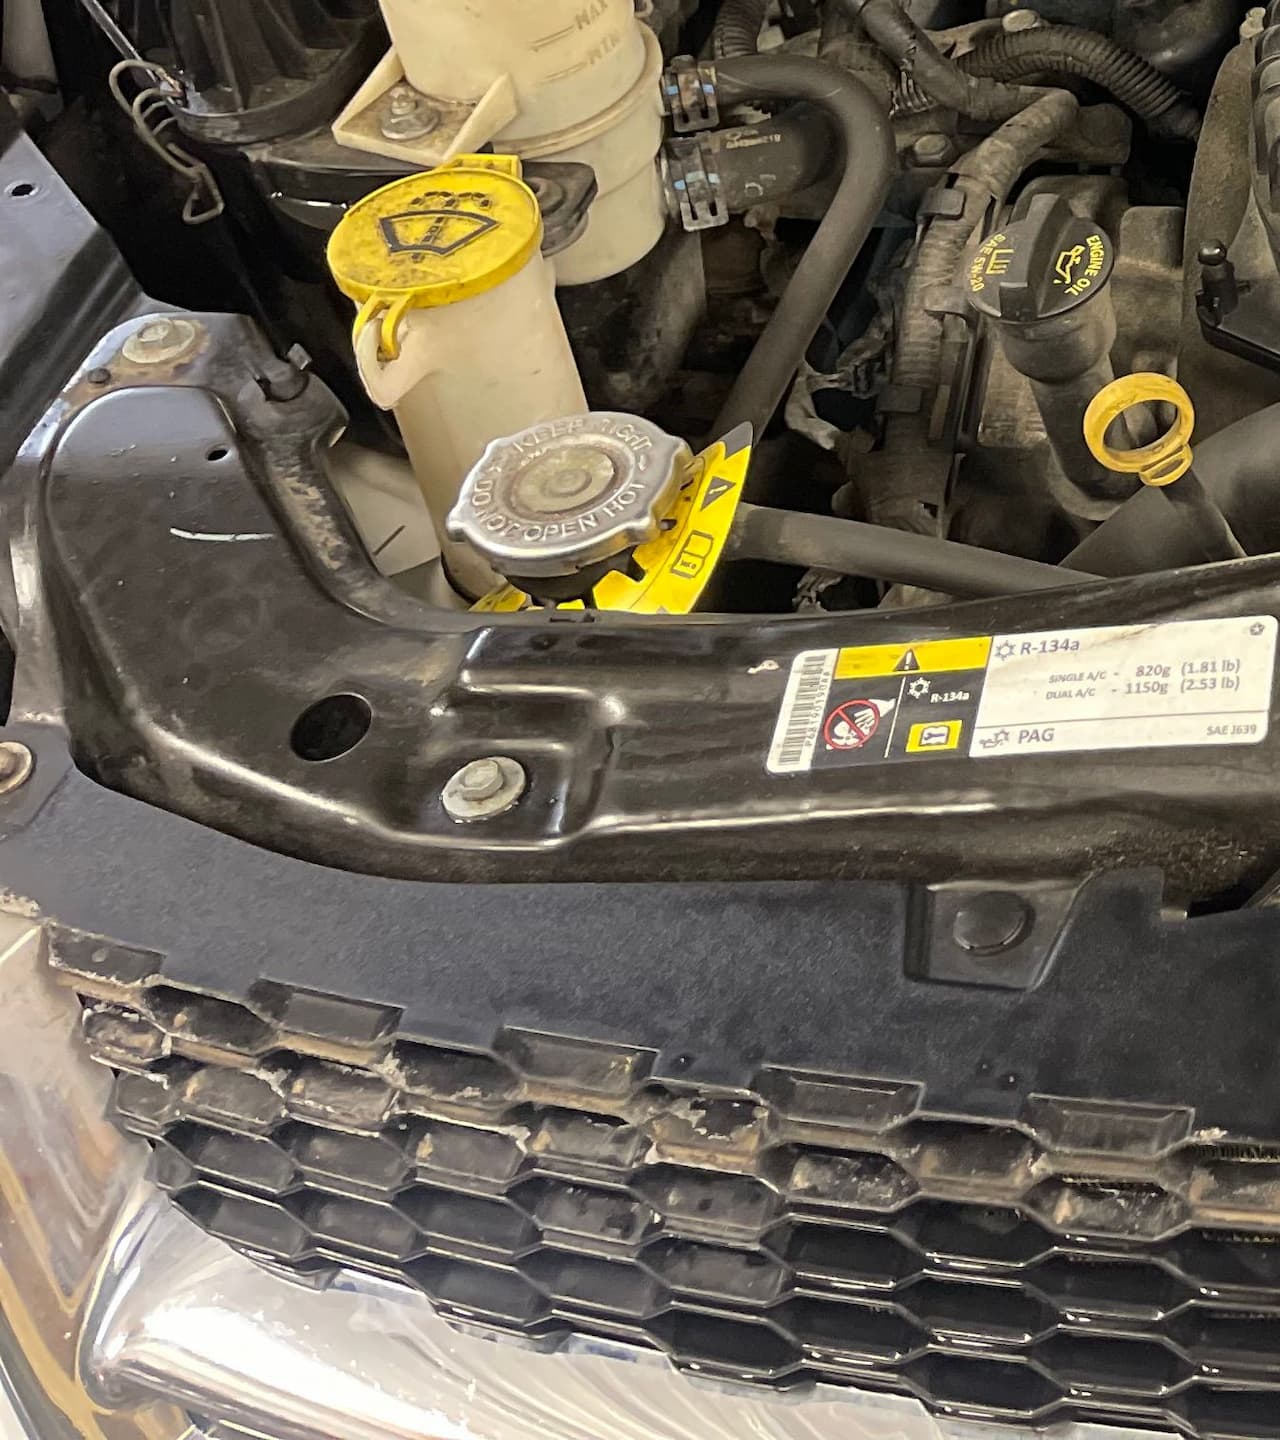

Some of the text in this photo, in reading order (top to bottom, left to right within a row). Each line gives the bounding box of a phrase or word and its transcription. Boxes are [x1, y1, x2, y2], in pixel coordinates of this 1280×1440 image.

[970, 256, 985, 292] 5W-20
[1064, 235, 1104, 296] ENGINE OIL
[512, 419, 585, 454] KEEP
[471, 479, 646, 542] DO NOT OPEN HOT
[1020, 638, 1080, 656] R-134a
[1048, 672, 1085, 684] SINGLE
[1087, 670, 1107, 681] A/C
[1135, 664, 1171, 680] 820g
[1181, 661, 1218, 677] (1.81
[1221, 659, 1241, 674] lb)
[930, 691, 970, 703] R-134a
[1045, 689, 1073, 700] DUAL
[1075, 687, 1096, 699] A/C
[1125, 681, 1169, 696] 1150g
[1180, 678, 1218, 695] (2.53
[1221, 676, 1241, 692] lb)
[1018, 728, 1055, 745] PAG
[1206, 724, 1257, 736] SAE J639
